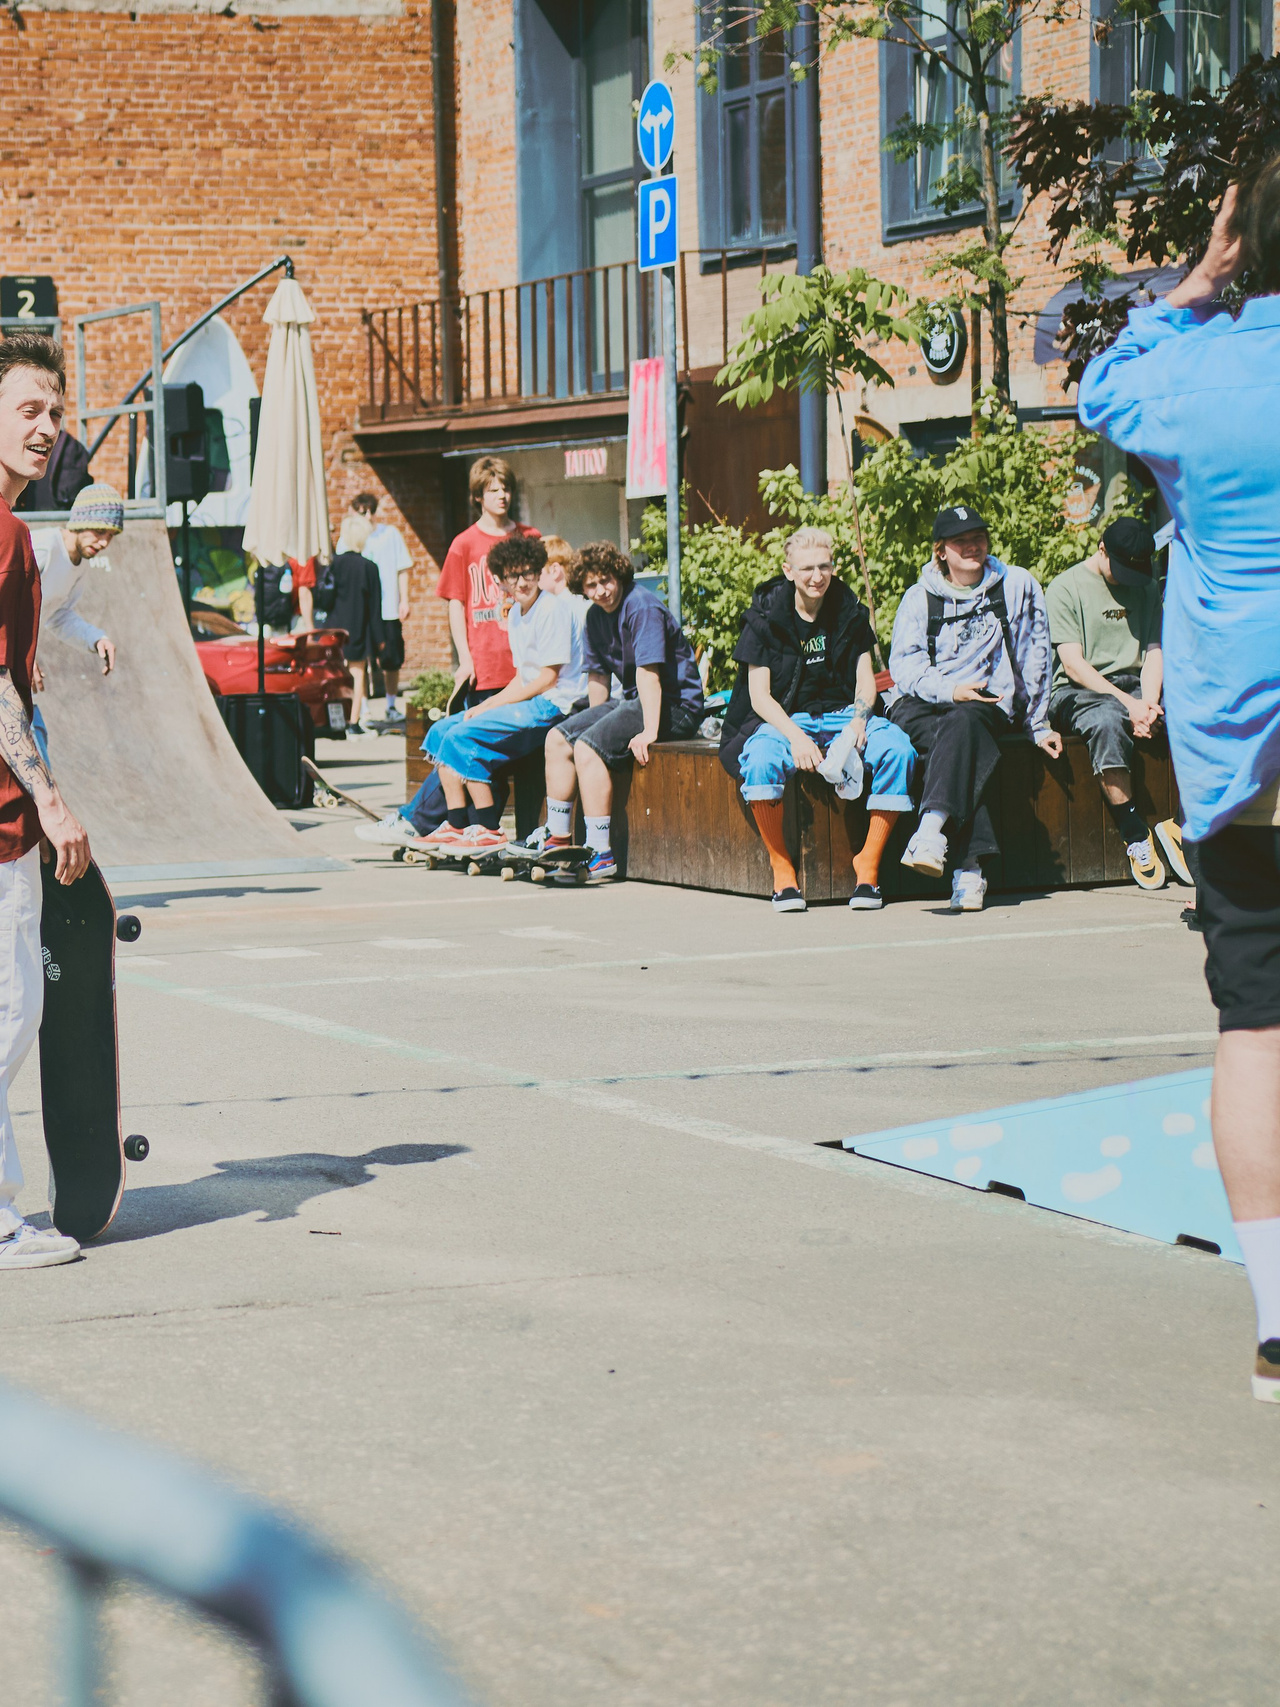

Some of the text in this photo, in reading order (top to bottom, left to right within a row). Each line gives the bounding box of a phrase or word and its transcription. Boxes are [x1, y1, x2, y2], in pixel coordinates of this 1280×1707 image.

[649, 187, 671, 259] P
[17, 290, 35, 318] 2
[564, 447, 608, 479] TATTOO
